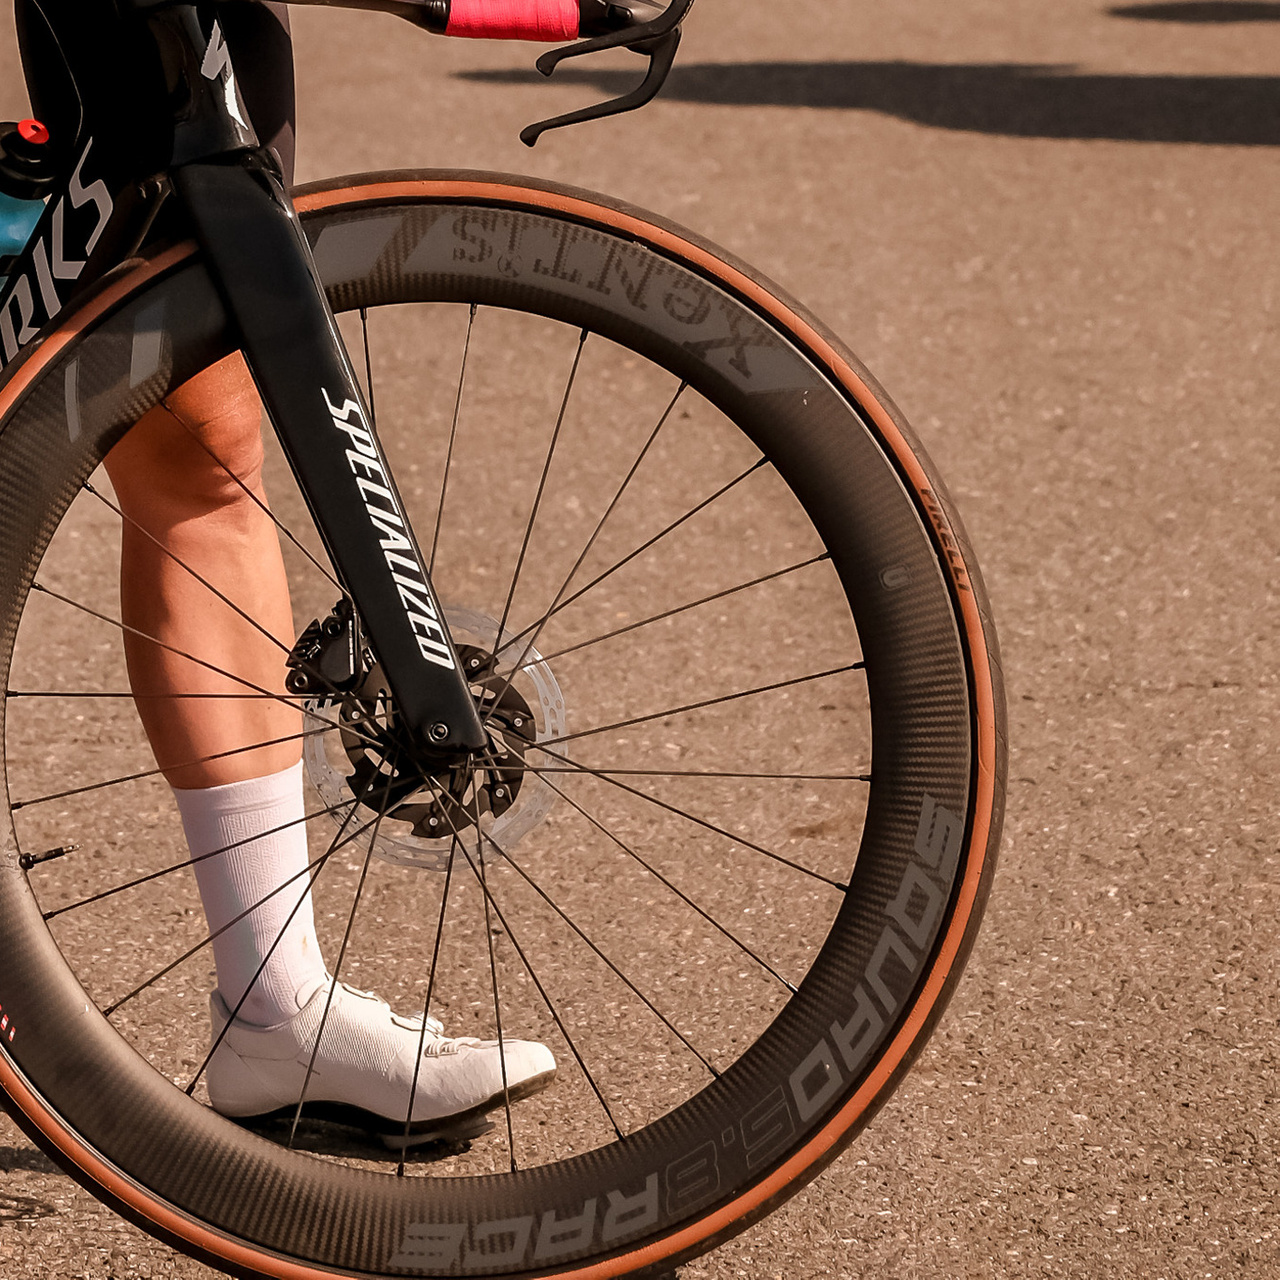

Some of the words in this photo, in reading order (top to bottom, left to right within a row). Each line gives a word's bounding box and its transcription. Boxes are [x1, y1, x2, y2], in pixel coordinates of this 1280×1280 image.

[320, 387, 456, 671] SPECIALIZED
[921, 487, 971, 593] PIRELLI
[789, 793, 966, 1122] SQUAD
[387, 1173, 661, 1270] RACE
